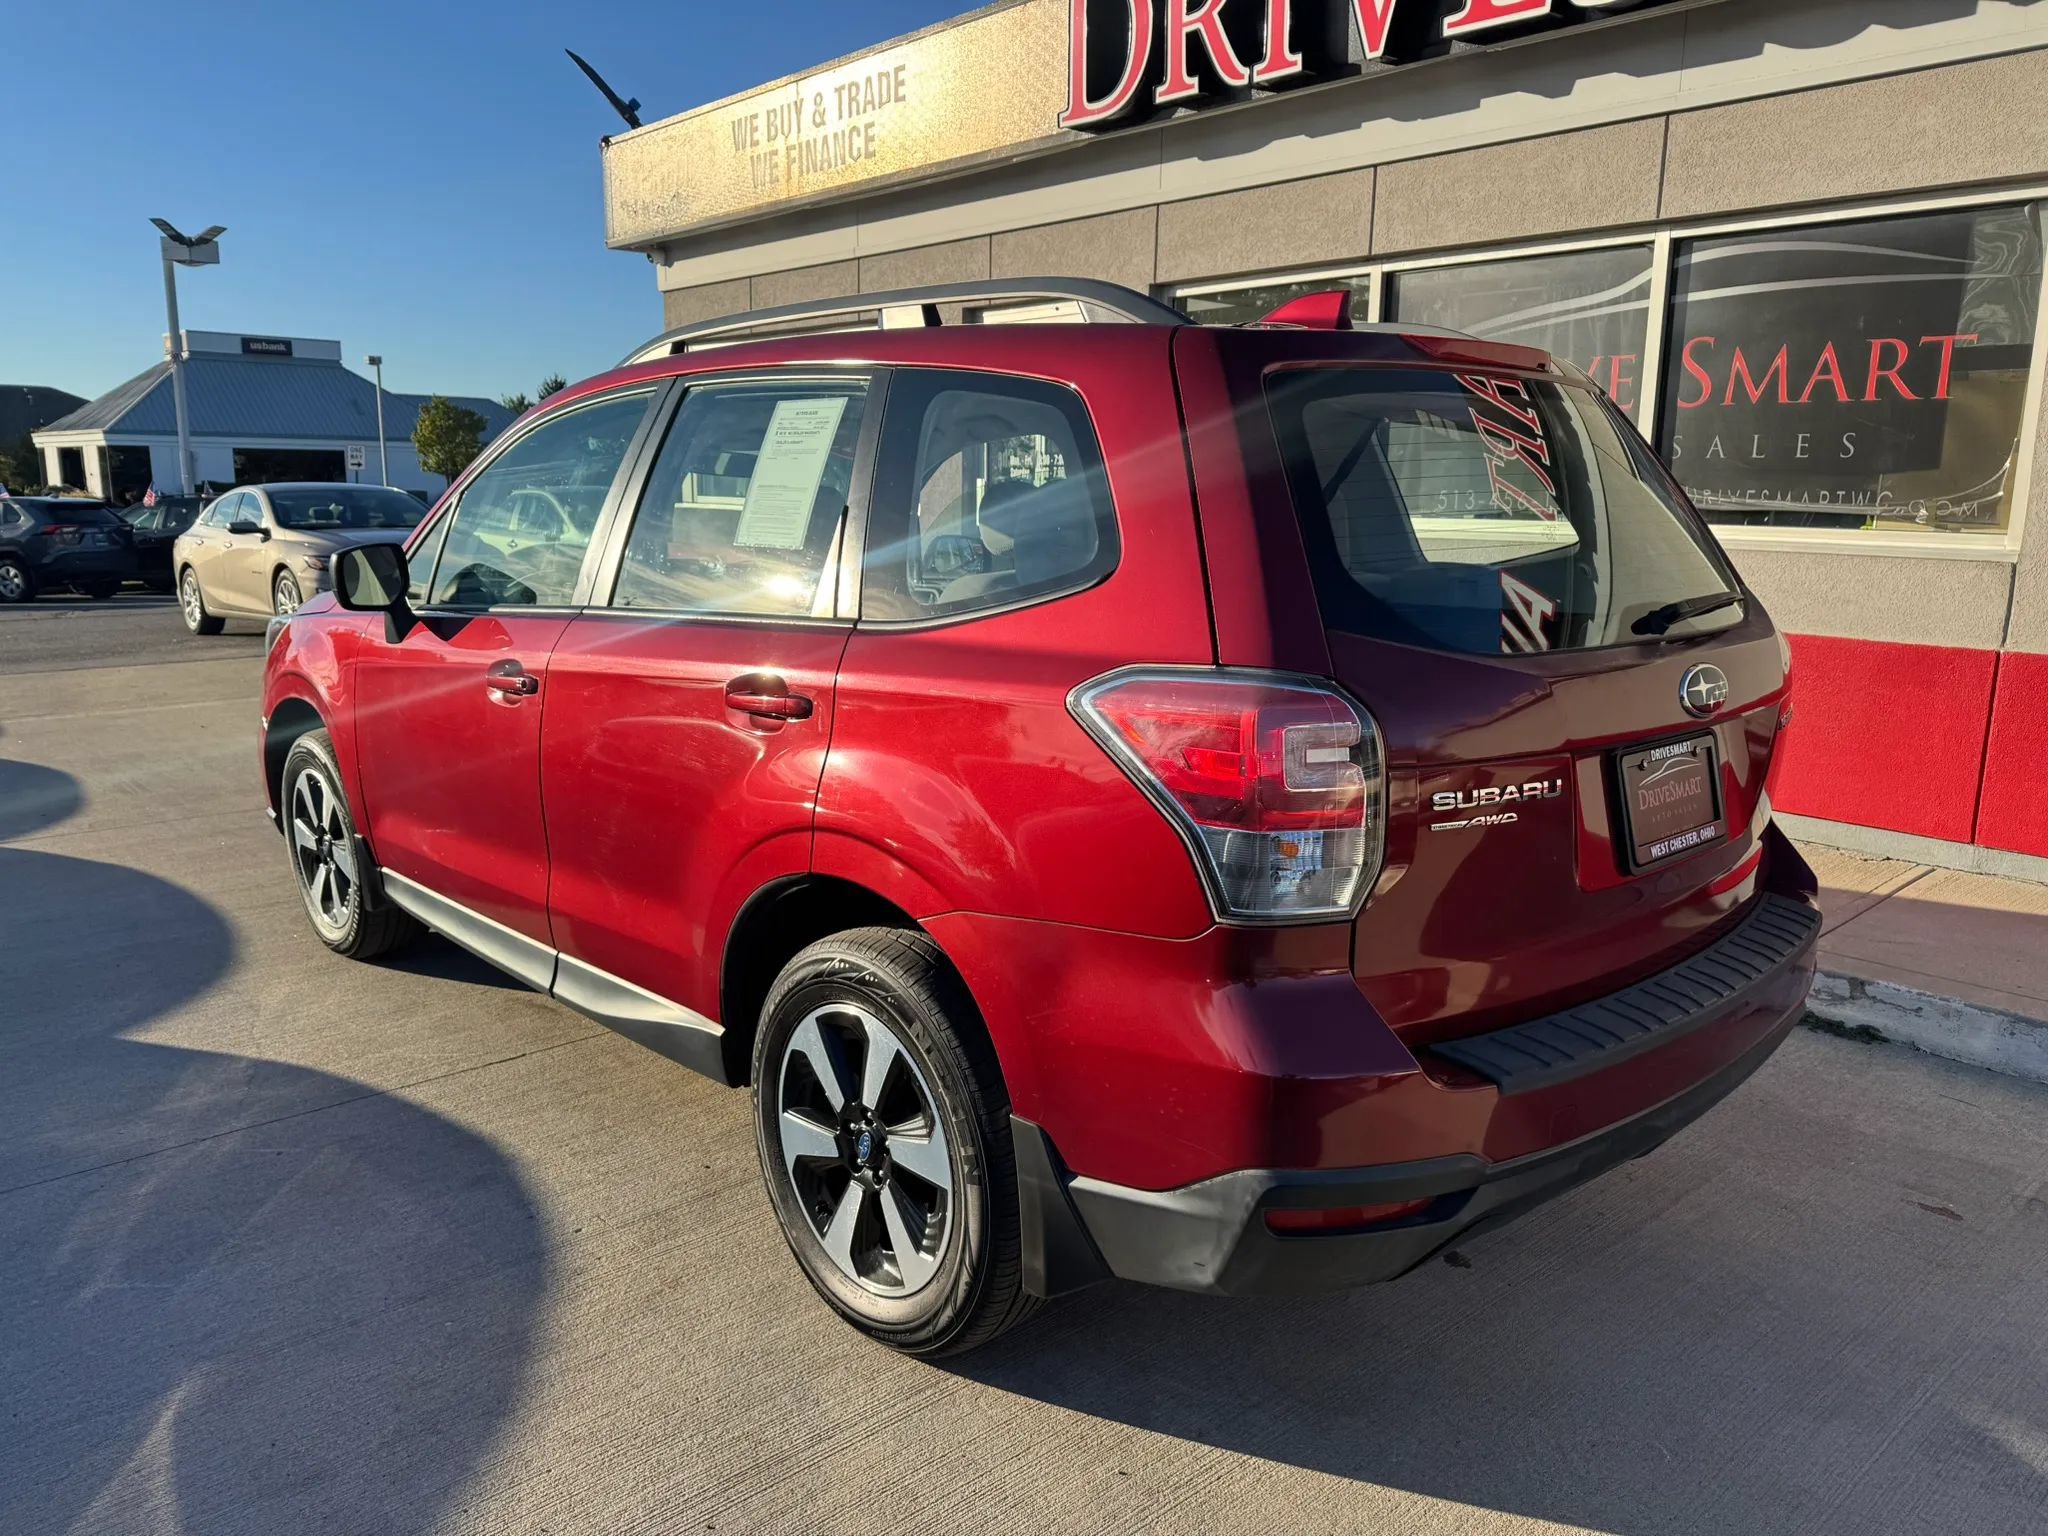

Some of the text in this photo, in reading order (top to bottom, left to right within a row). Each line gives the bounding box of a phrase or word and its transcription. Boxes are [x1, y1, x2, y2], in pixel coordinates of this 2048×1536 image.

[731, 63, 906, 152] WE BUY & TRADE
[750, 121, 876, 189] WE FINANCE
[1677, 334, 1979, 411] SMART
[1672, 432, 1857, 460] SALES
[1650, 741, 1693, 762] DRIVESMART
[1432, 778, 1563, 811] SUBARU
[1465, 812, 1519, 828] AWD
[1650, 842, 1669, 858] WEST
[1669, 832, 1701, 851] CHESTER,
[1700, 826, 1716, 840] OHIO
